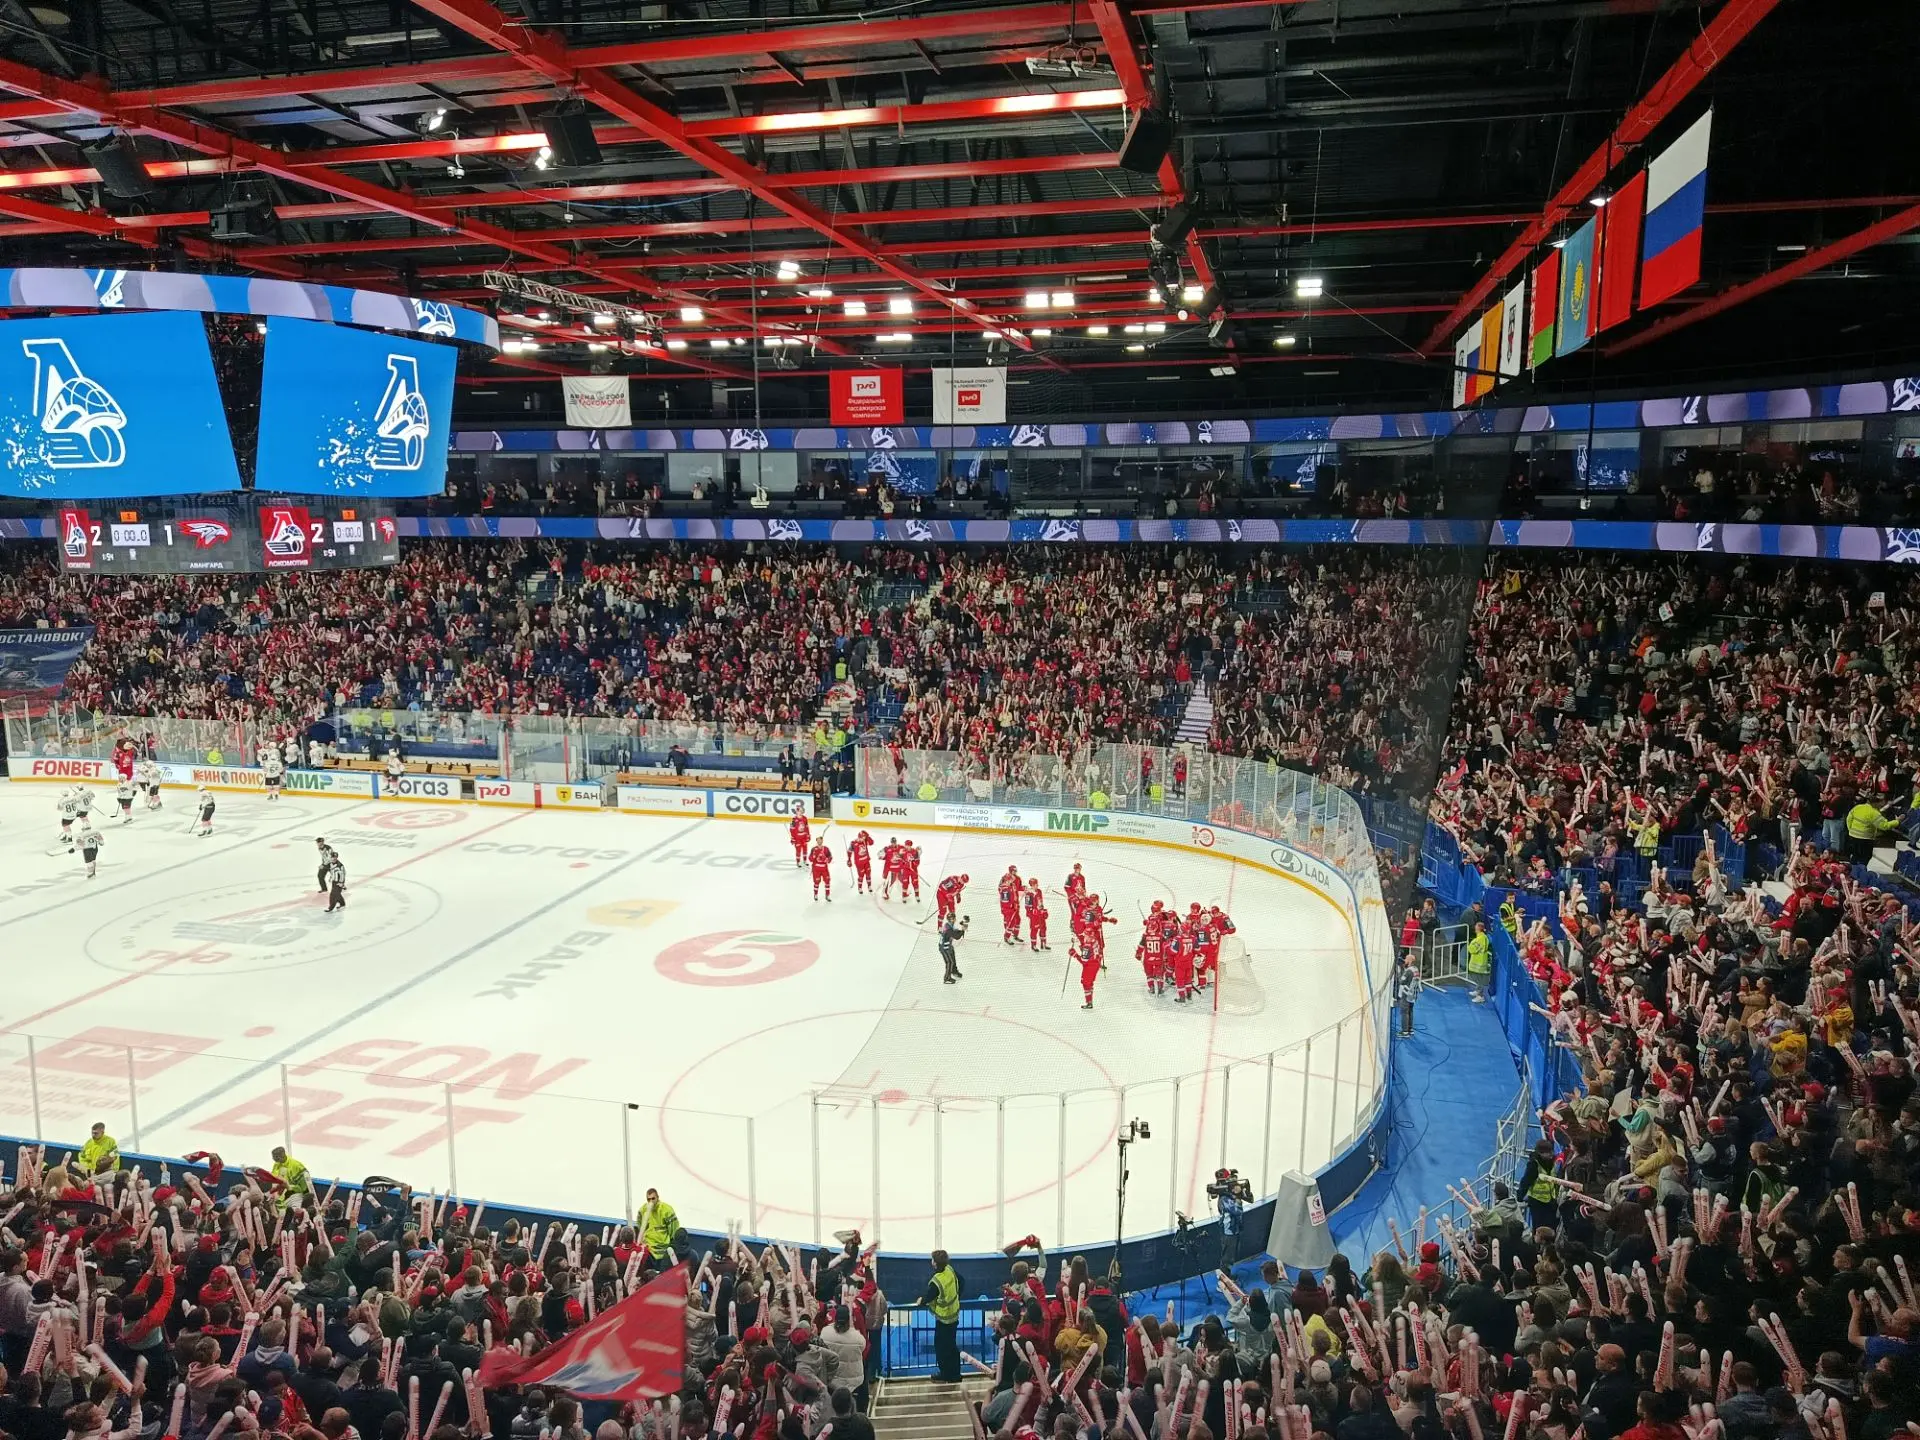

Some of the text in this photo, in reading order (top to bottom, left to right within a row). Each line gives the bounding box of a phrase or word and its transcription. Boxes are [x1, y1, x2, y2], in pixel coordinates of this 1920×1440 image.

[91, 525, 102, 546] 2
[164, 525, 173, 545] 1
[311, 523, 324, 543] 2
[370, 522, 376, 541] 1
[32, 760, 103, 777] FONBET
[287, 774, 333, 790] МИР
[873, 806, 908, 817] БАНК
[1047, 812, 1110, 833] МИР
[1303, 862, 1331, 889] LADA
[1146, 941, 1160, 953] 90
[288, 1038, 591, 1100] FON
[188, 1085, 526, 1159] BET
